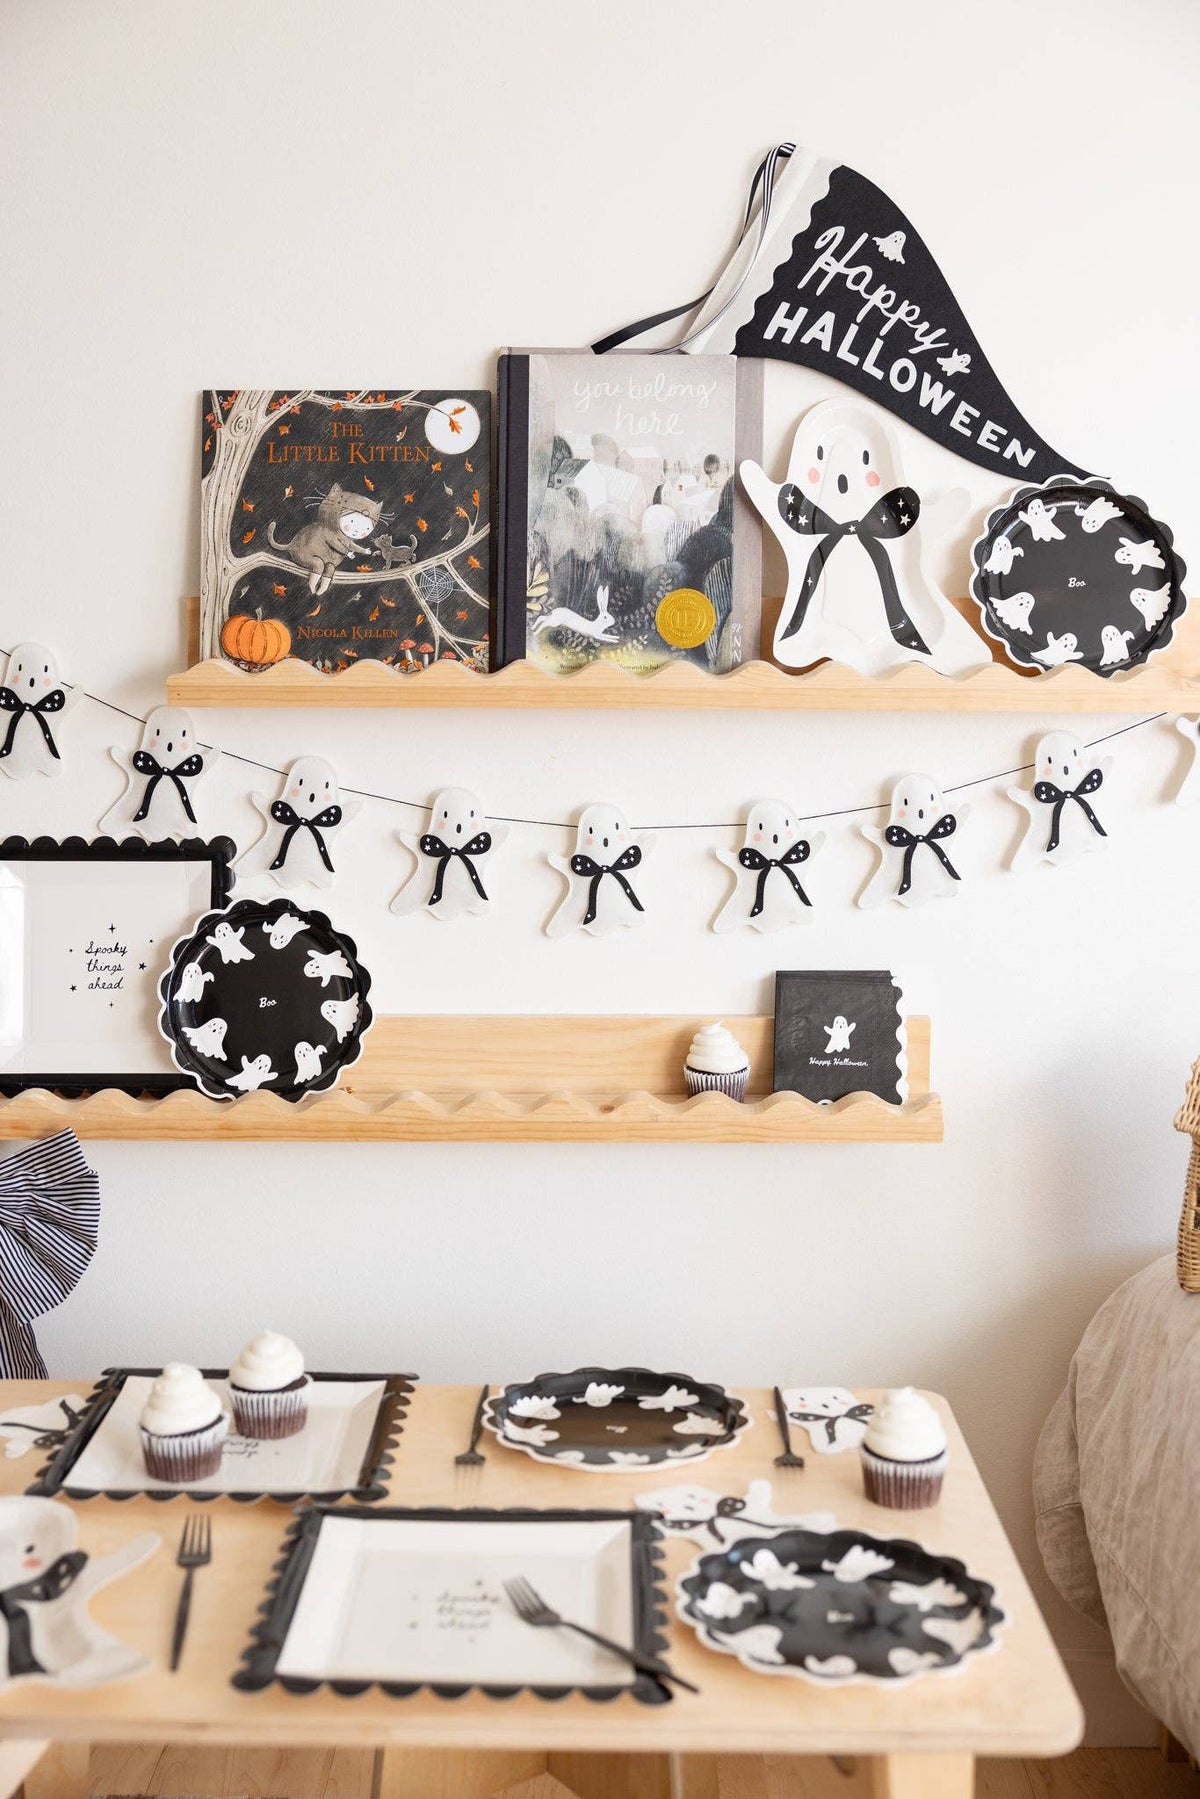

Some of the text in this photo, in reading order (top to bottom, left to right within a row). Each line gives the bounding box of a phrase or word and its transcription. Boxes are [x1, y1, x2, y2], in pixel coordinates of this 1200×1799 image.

[797, 226, 950, 354] Happy
[574, 372, 718, 413] you belong
[762, 301, 1037, 468] HALLOWEEN
[615, 403, 685, 436] here
[328, 421, 364, 439] THE
[267, 441, 432, 464] LITTLE KITTEN
[1068, 576, 1086, 588] Boo
[296, 625, 398, 640] NICOLA KILLEN
[85, 940, 128, 957] Spooky
[86, 958, 124, 976] things
[88, 976, 124, 990] ahead
[259, 996, 277, 1008] Boo
[809, 1057, 869, 1067] Happy Halloween
